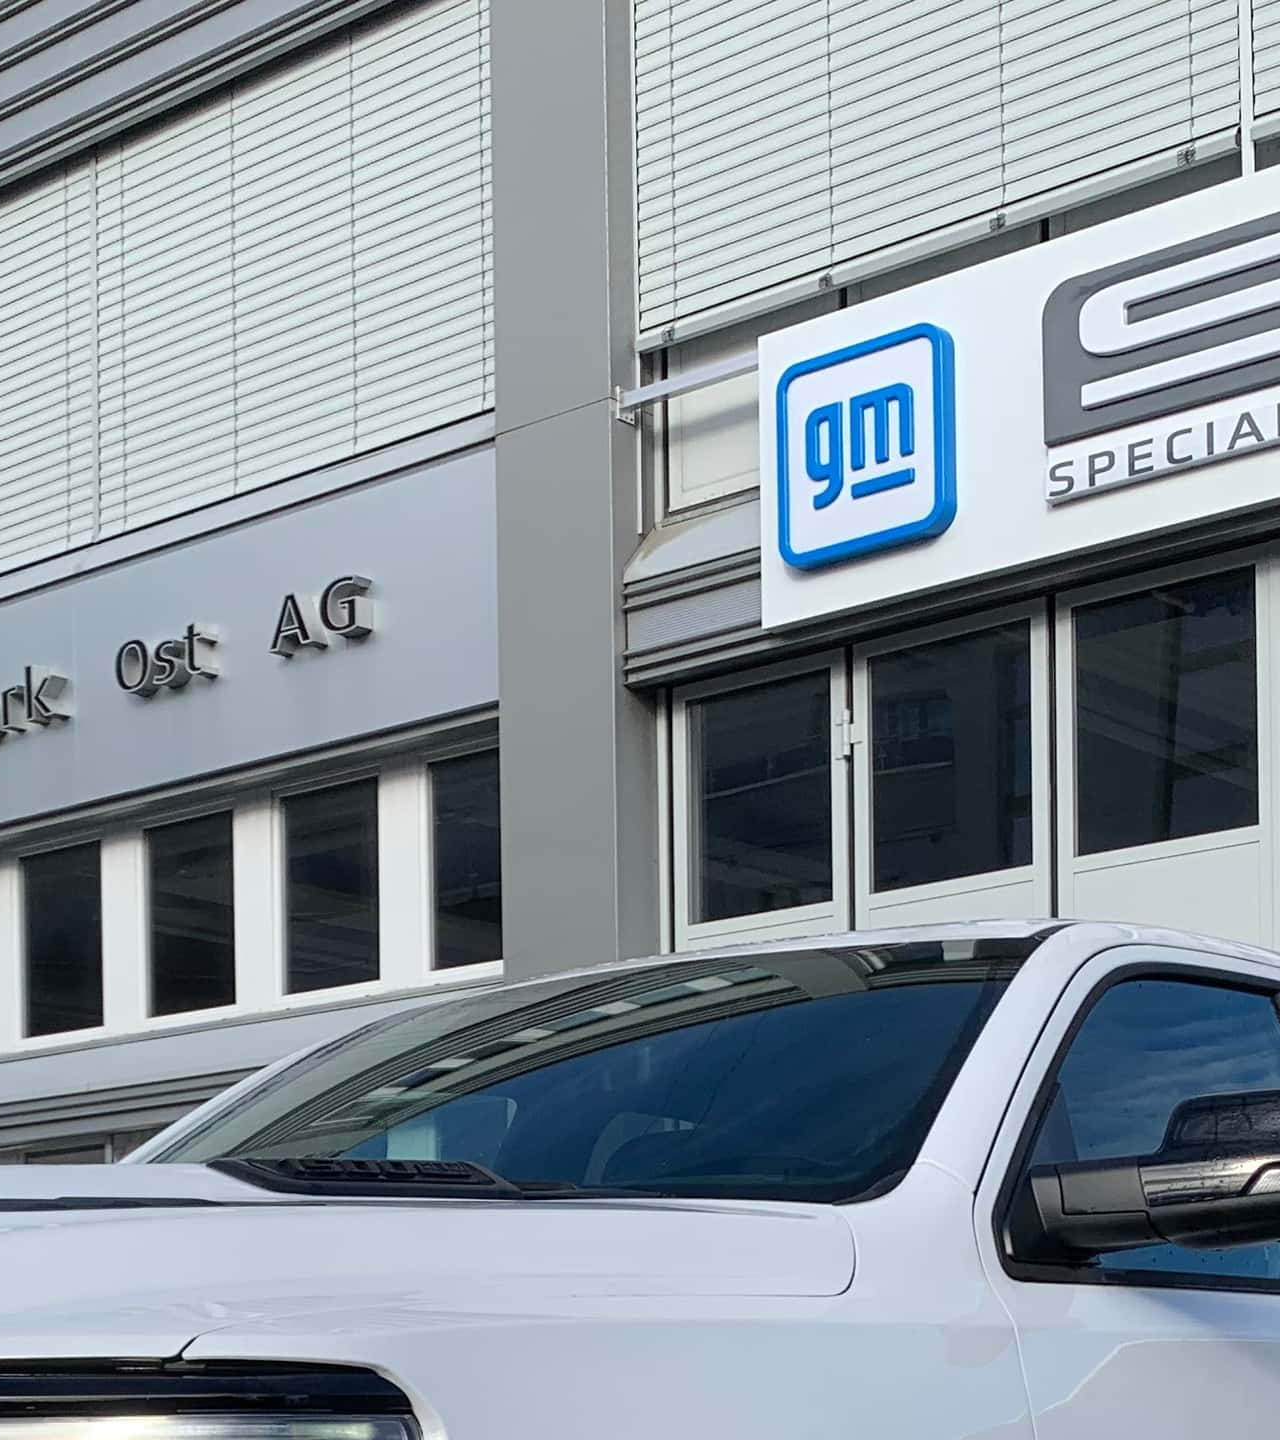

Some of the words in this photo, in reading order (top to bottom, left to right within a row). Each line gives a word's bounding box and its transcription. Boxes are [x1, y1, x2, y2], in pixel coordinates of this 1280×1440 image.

[804, 382, 916, 511] gm
[114, 623, 220, 697] Ost
[270, 575, 373, 657] AG
